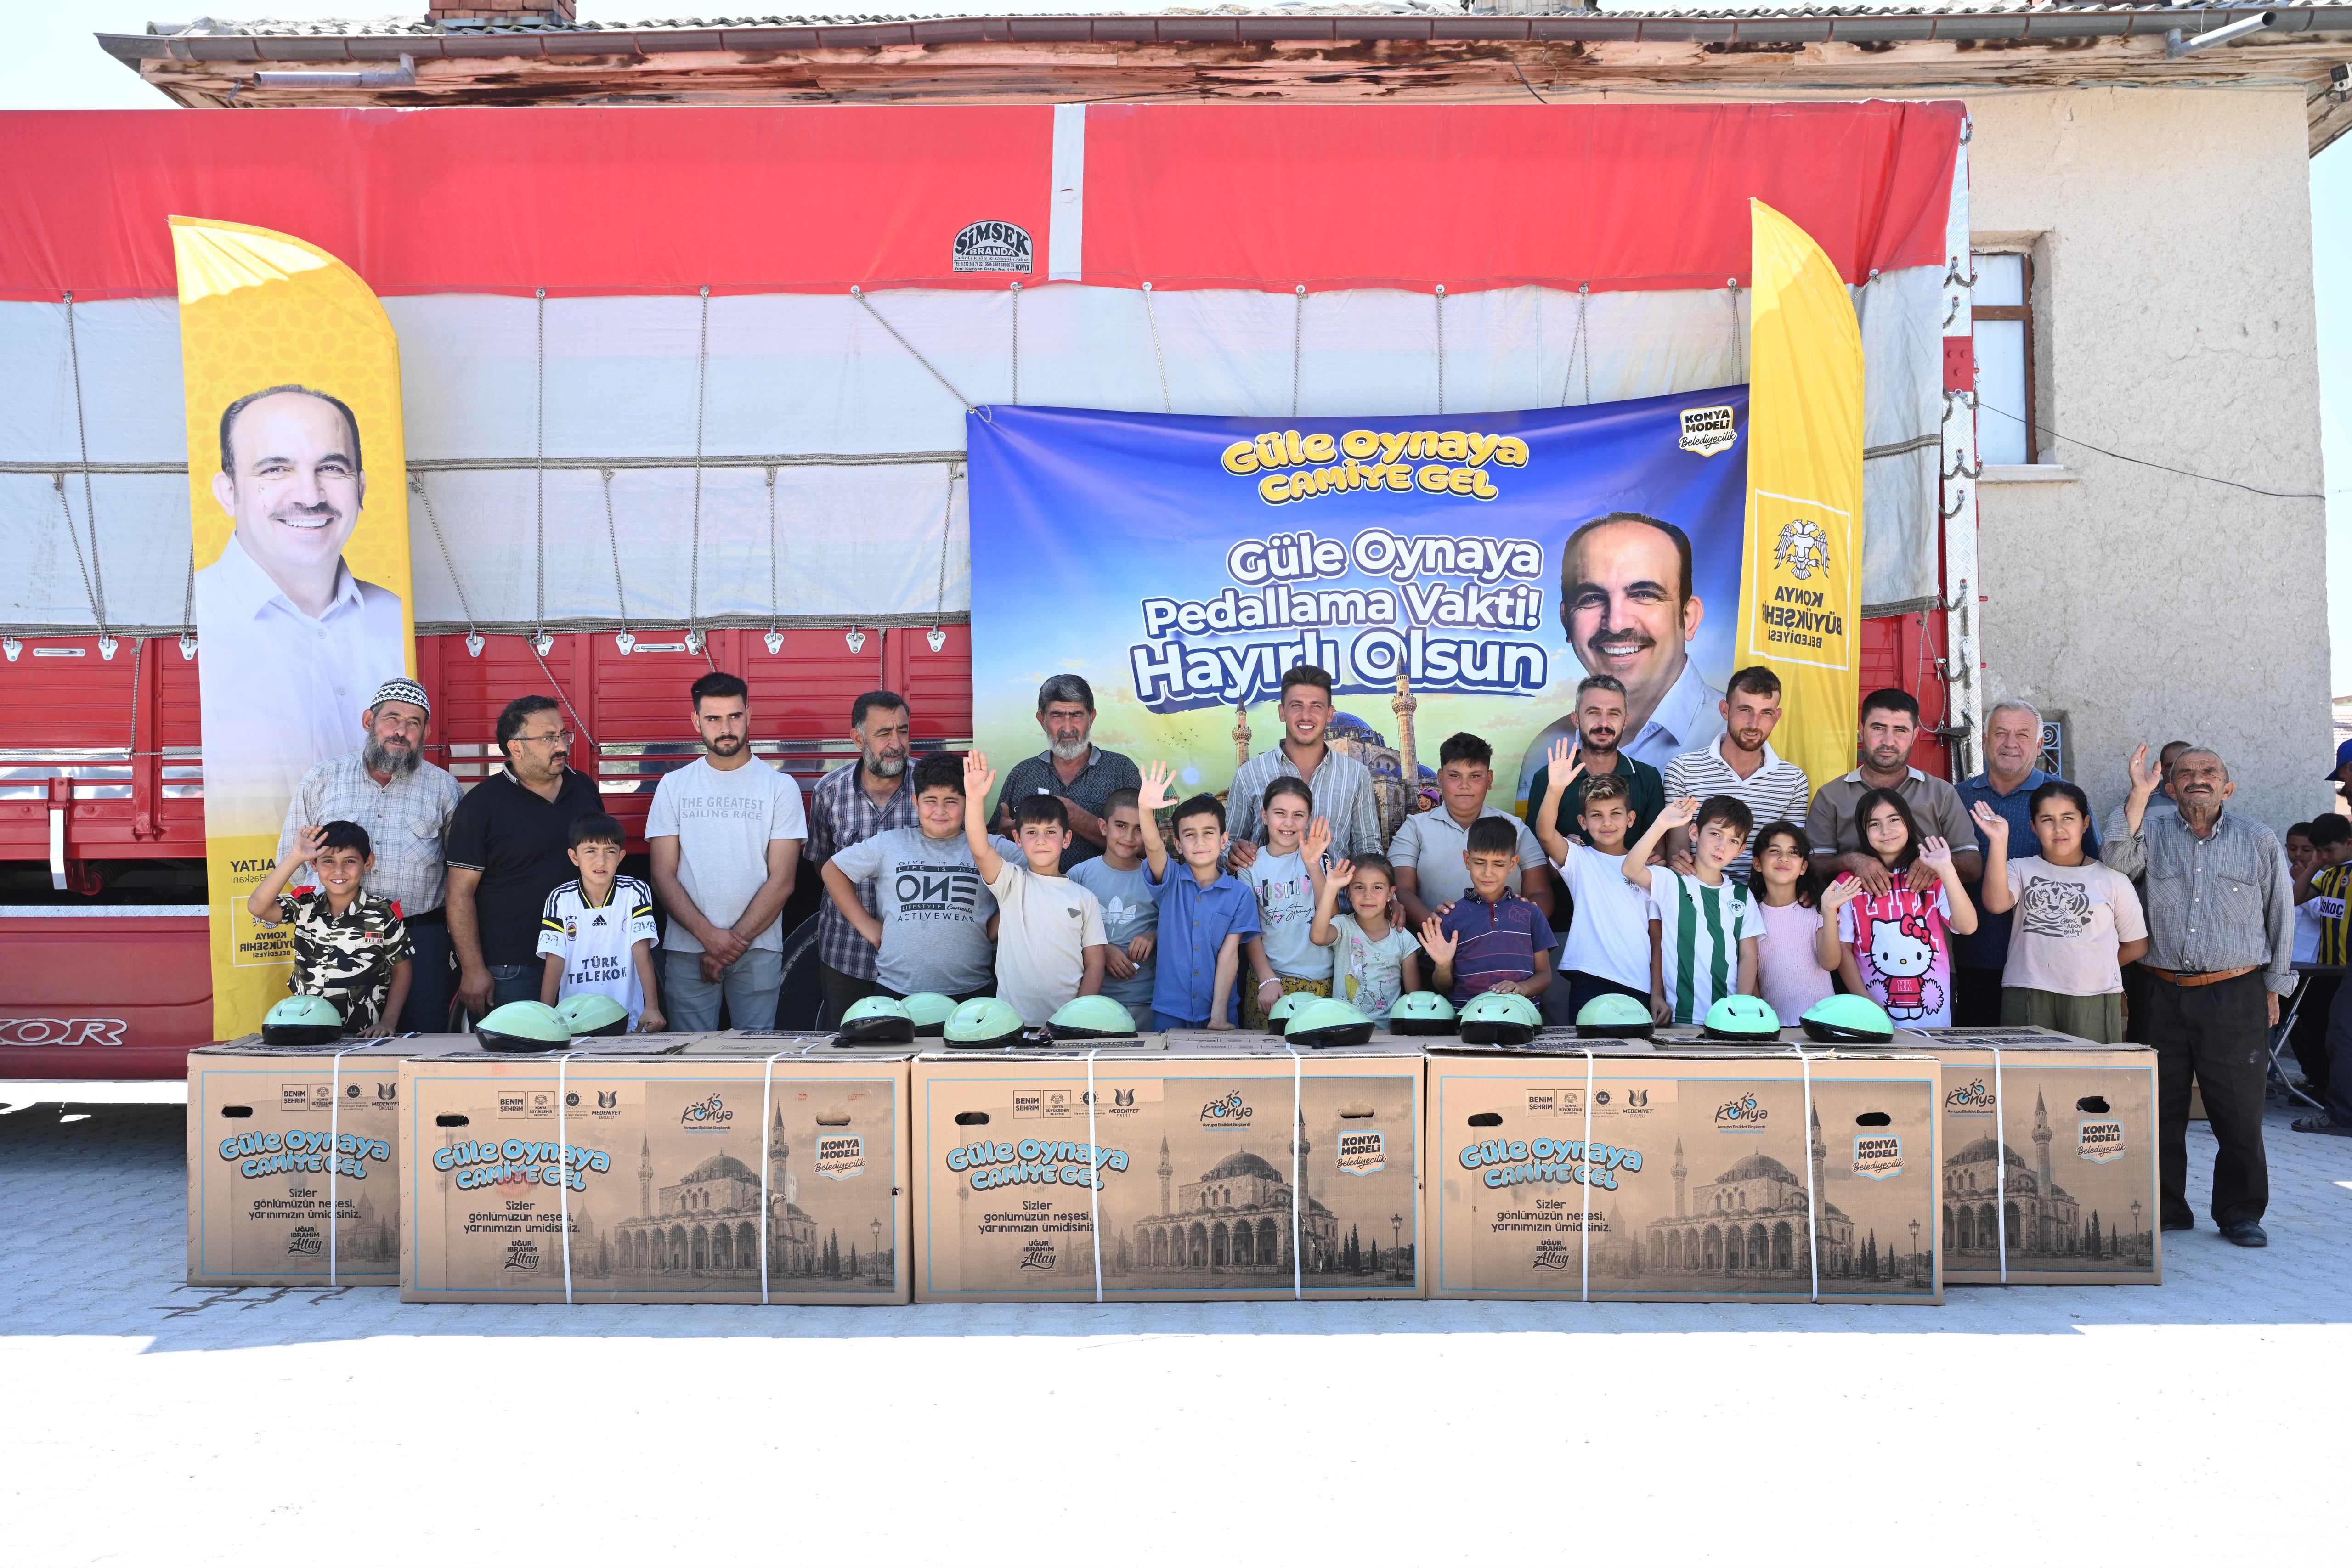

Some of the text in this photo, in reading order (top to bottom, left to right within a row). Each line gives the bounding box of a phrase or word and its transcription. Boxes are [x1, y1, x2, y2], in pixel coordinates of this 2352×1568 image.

[970, 247, 1015, 255] BRANDA
[1685, 409, 1730, 423] KONYA
[1680, 430, 1736, 449] Belediyecilik
[1222, 430, 1528, 474] Güle Oynaya
[1418, 465, 1498, 501] GEL
[1229, 531, 1540, 582] Güle Oynaya
[1145, 585, 1540, 637] Pedallama Vakti!
[1133, 628, 1545, 700] Hayırlı Olsun
[682, 797, 764, 810] THE GREATEST
[682, 810, 761, 820] SAILING RACE
[947, 904, 972, 913] Camenta
[1266, 902, 1314, 925] Stay Strong
[897, 912, 975, 923] ACTIVEWEAR
[582, 956, 618, 970] TÜRK
[1897, 980, 1912, 992] HK
[0, 1018, 127, 1046] OR
[681, 1106, 733, 1124] Konya
[2082, 1124, 2120, 1135] KONYA
[220, 1130, 390, 1161] Güle Oynaya
[821, 1139, 859, 1150] KONYA
[1342, 1135, 1380, 1146] KONYA
[1859, 1139, 1898, 1150] KONYA
[433, 1139, 611, 1173] Güle Oynaya
[946, 1139, 1129, 1172] Güle Oynaya
[1459, 1138, 1643, 1171] Güle Oynaya
[2077, 1142, 2126, 1156] Belediyecilik
[324, 1155, 367, 1180] GEL
[814, 1158, 866, 1173] Belediyecilik
[1336, 1153, 1387, 1169] Belediyecilik
[1852, 1158, 1904, 1173] Belediyecilik
[543, 1167, 586, 1192] GEL
[1059, 1165, 1104, 1191] GEL
[1573, 1164, 1618, 1191] GEL
[289, 1189, 317, 1197] Sizler
[254, 1199, 315, 1210] gönlümüzün
[506, 1201, 535, 1210] Sizler
[1023, 1201, 1052, 1210] Sizler
[1536, 1199, 1566, 1209] Sizler
[249, 1212, 304, 1220] yarınımızın
[469, 1212, 532, 1223] gönlümüzün
[984, 1211, 1092, 1223] gönlümüzün neşesi,
[1497, 1210, 1563, 1222] gönlümüzün
[464, 1225, 521, 1234] yarınımızın
[978, 1225, 1038, 1234] yarınımızın
[1491, 1223, 1551, 1232] yarınımızın
[288, 1238, 322, 1254] Altay
[1020, 1252, 1057, 1269] Altay
[1532, 1252, 1569, 1269] Altay
